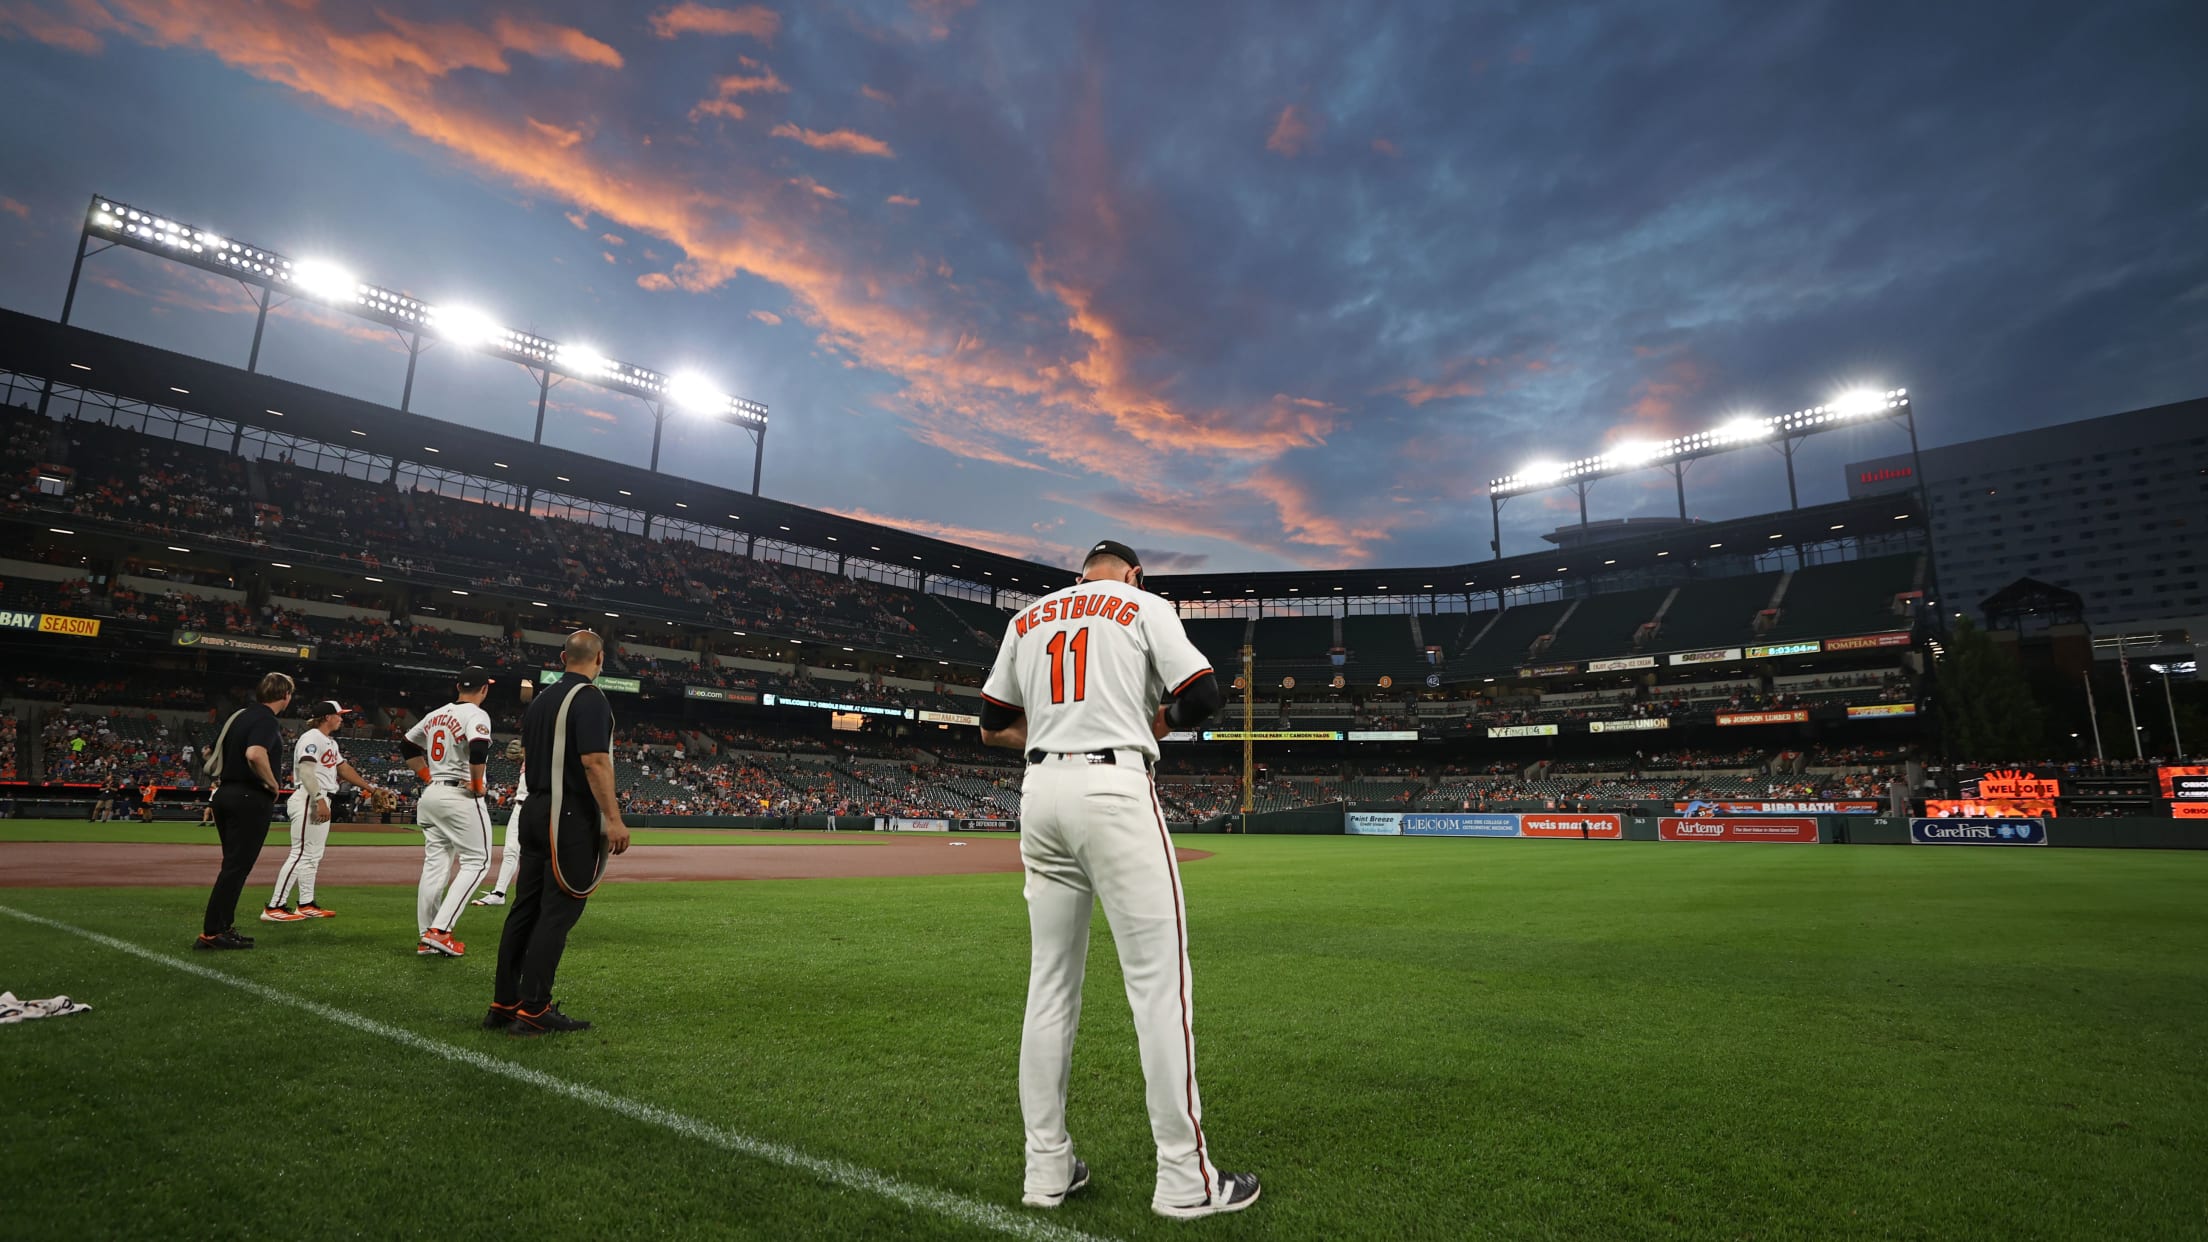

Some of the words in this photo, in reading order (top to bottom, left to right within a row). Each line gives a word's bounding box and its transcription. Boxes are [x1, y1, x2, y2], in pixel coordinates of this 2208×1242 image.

[1861, 467, 1912, 484] Hilton
[1014, 594, 1140, 638] WESTBURG
[44, 616, 96, 635] SEASON
[1827, 639, 1878, 651] POMPEIAN
[1046, 626, 1089, 705] 11
[1428, 677, 1437, 685] 42
[688, 688, 723, 699] ubeo.com
[779, 698, 809, 707] WELCOME
[810, 700, 818, 708] TO
[818, 702, 839, 710] ORIOLE
[861, 706, 884, 715] CAMDEN
[1635, 718, 1669, 729] UNION
[431, 729, 446, 762] 6
[1762, 803, 1795, 812] BIRD
[1799, 803, 1835, 812] BATH
[912, 820, 929, 829] Chill
[1369, 815, 1394, 823] Breeze
[1527, 819, 1557, 830] weis
[1676, 821, 1725, 836] Airtemp
[1924, 824, 1997, 838] CareFirst
